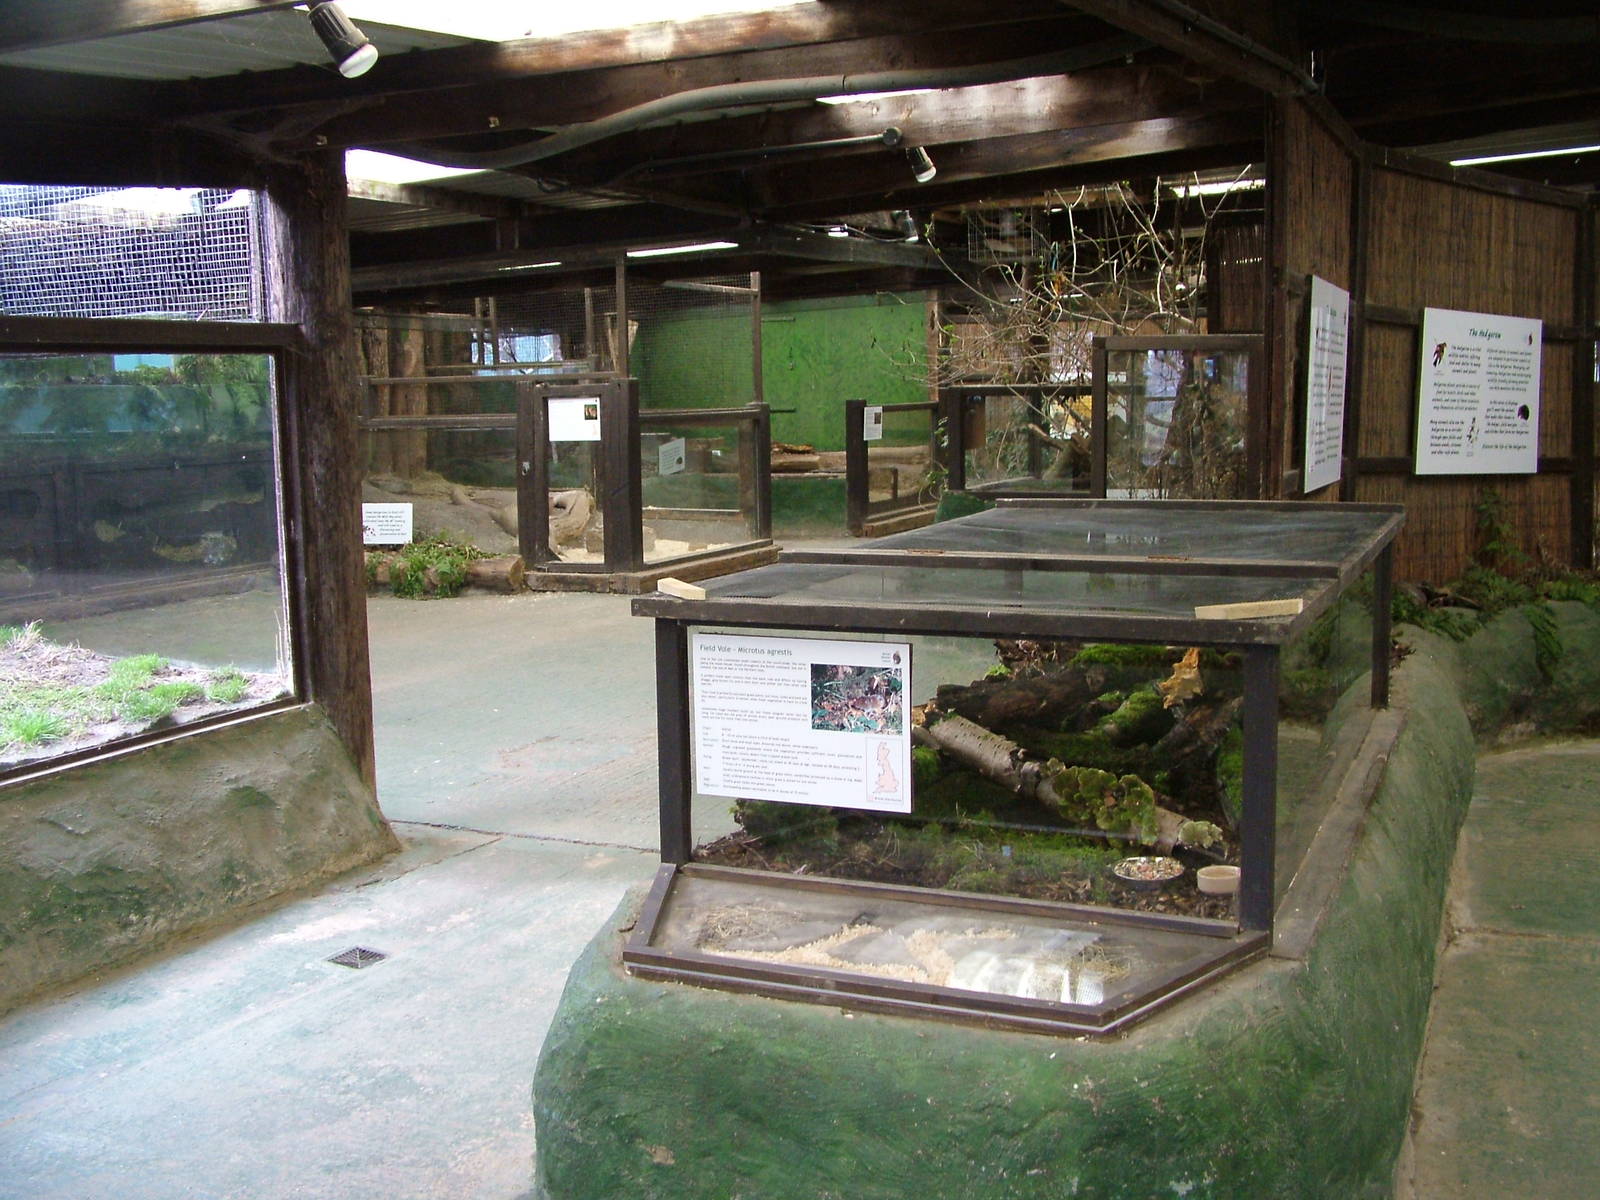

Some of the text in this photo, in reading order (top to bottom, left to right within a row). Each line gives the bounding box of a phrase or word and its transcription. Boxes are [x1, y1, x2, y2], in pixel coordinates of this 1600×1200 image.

[699, 643, 715, 652] Field
[717, 644, 731, 653] Vole
[737, 646, 765, 655] Microtus
[767, 648, 793, 656] agrestis
